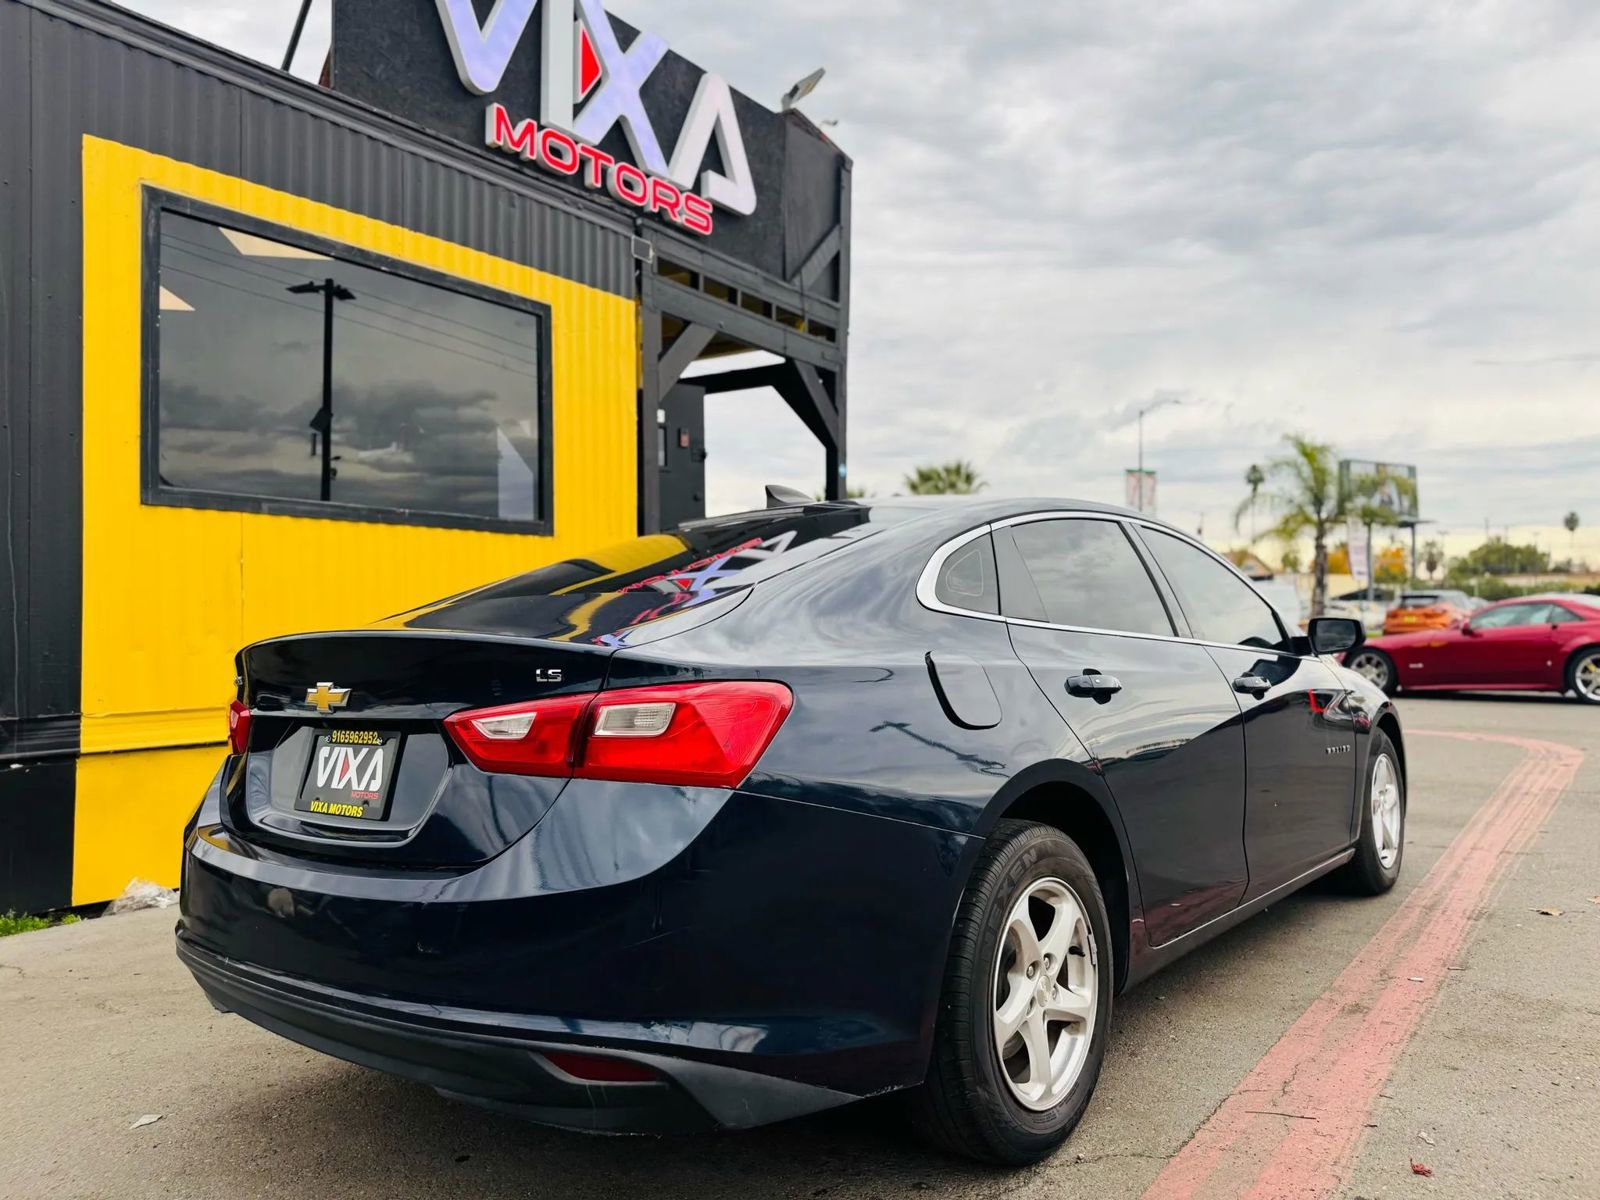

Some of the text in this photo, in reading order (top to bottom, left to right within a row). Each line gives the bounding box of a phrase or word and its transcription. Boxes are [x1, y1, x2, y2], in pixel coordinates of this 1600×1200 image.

[437, 0, 757, 215] VIXA
[486, 103, 712, 235] MOTORS
[536, 669, 562, 682] LS
[332, 730, 379, 744] 9165962952
[317, 746, 383, 791] VIXA
[310, 801, 364, 817] VIXA MOTORS
